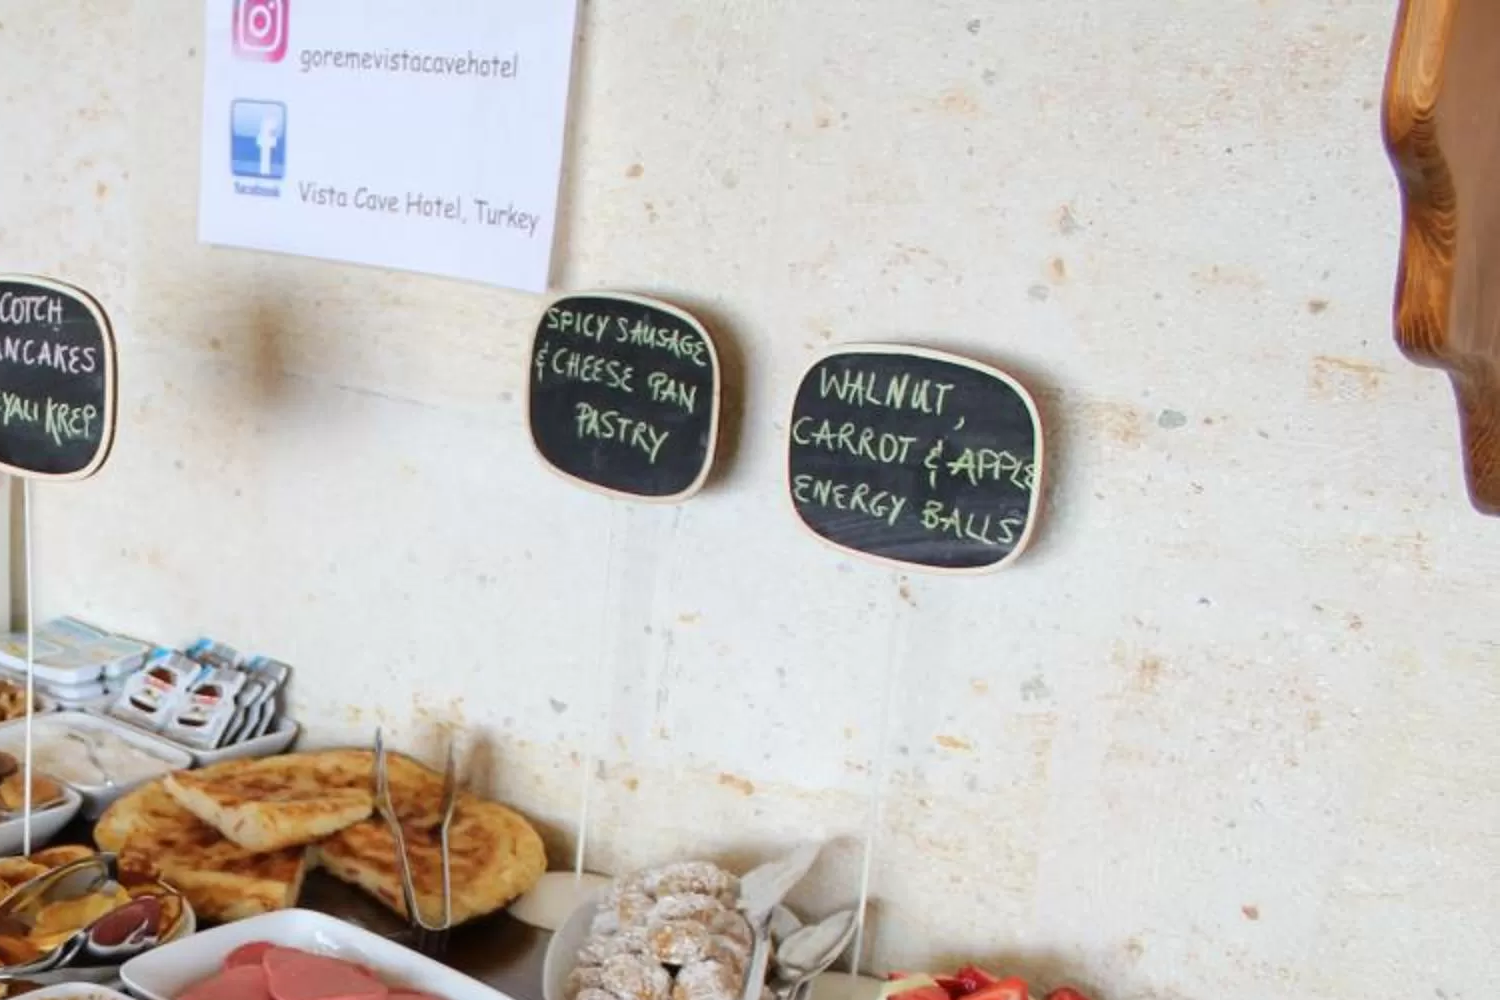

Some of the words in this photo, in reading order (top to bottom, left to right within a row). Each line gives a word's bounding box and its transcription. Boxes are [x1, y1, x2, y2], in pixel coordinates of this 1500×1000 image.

[300, 46, 519, 78] goremevistacavehotel
[299, 181, 348, 208] Vista
[354, 187, 399, 213] Cave
[406, 192, 466, 224] Hotel,
[473, 198, 541, 237] Turkey
[546, 307, 610, 343] SPICY
[616, 316, 707, 367] SAUSAGE
[551, 347, 634, 392] CHEESE
[647, 372, 698, 414] PAN
[45, 396, 97, 446] KREP
[575, 402, 669, 464] PASTRY
[793, 416, 916, 464] CARROT
[794, 475, 907, 526] ENERGY
[921, 501, 1023, 545] BALLS
